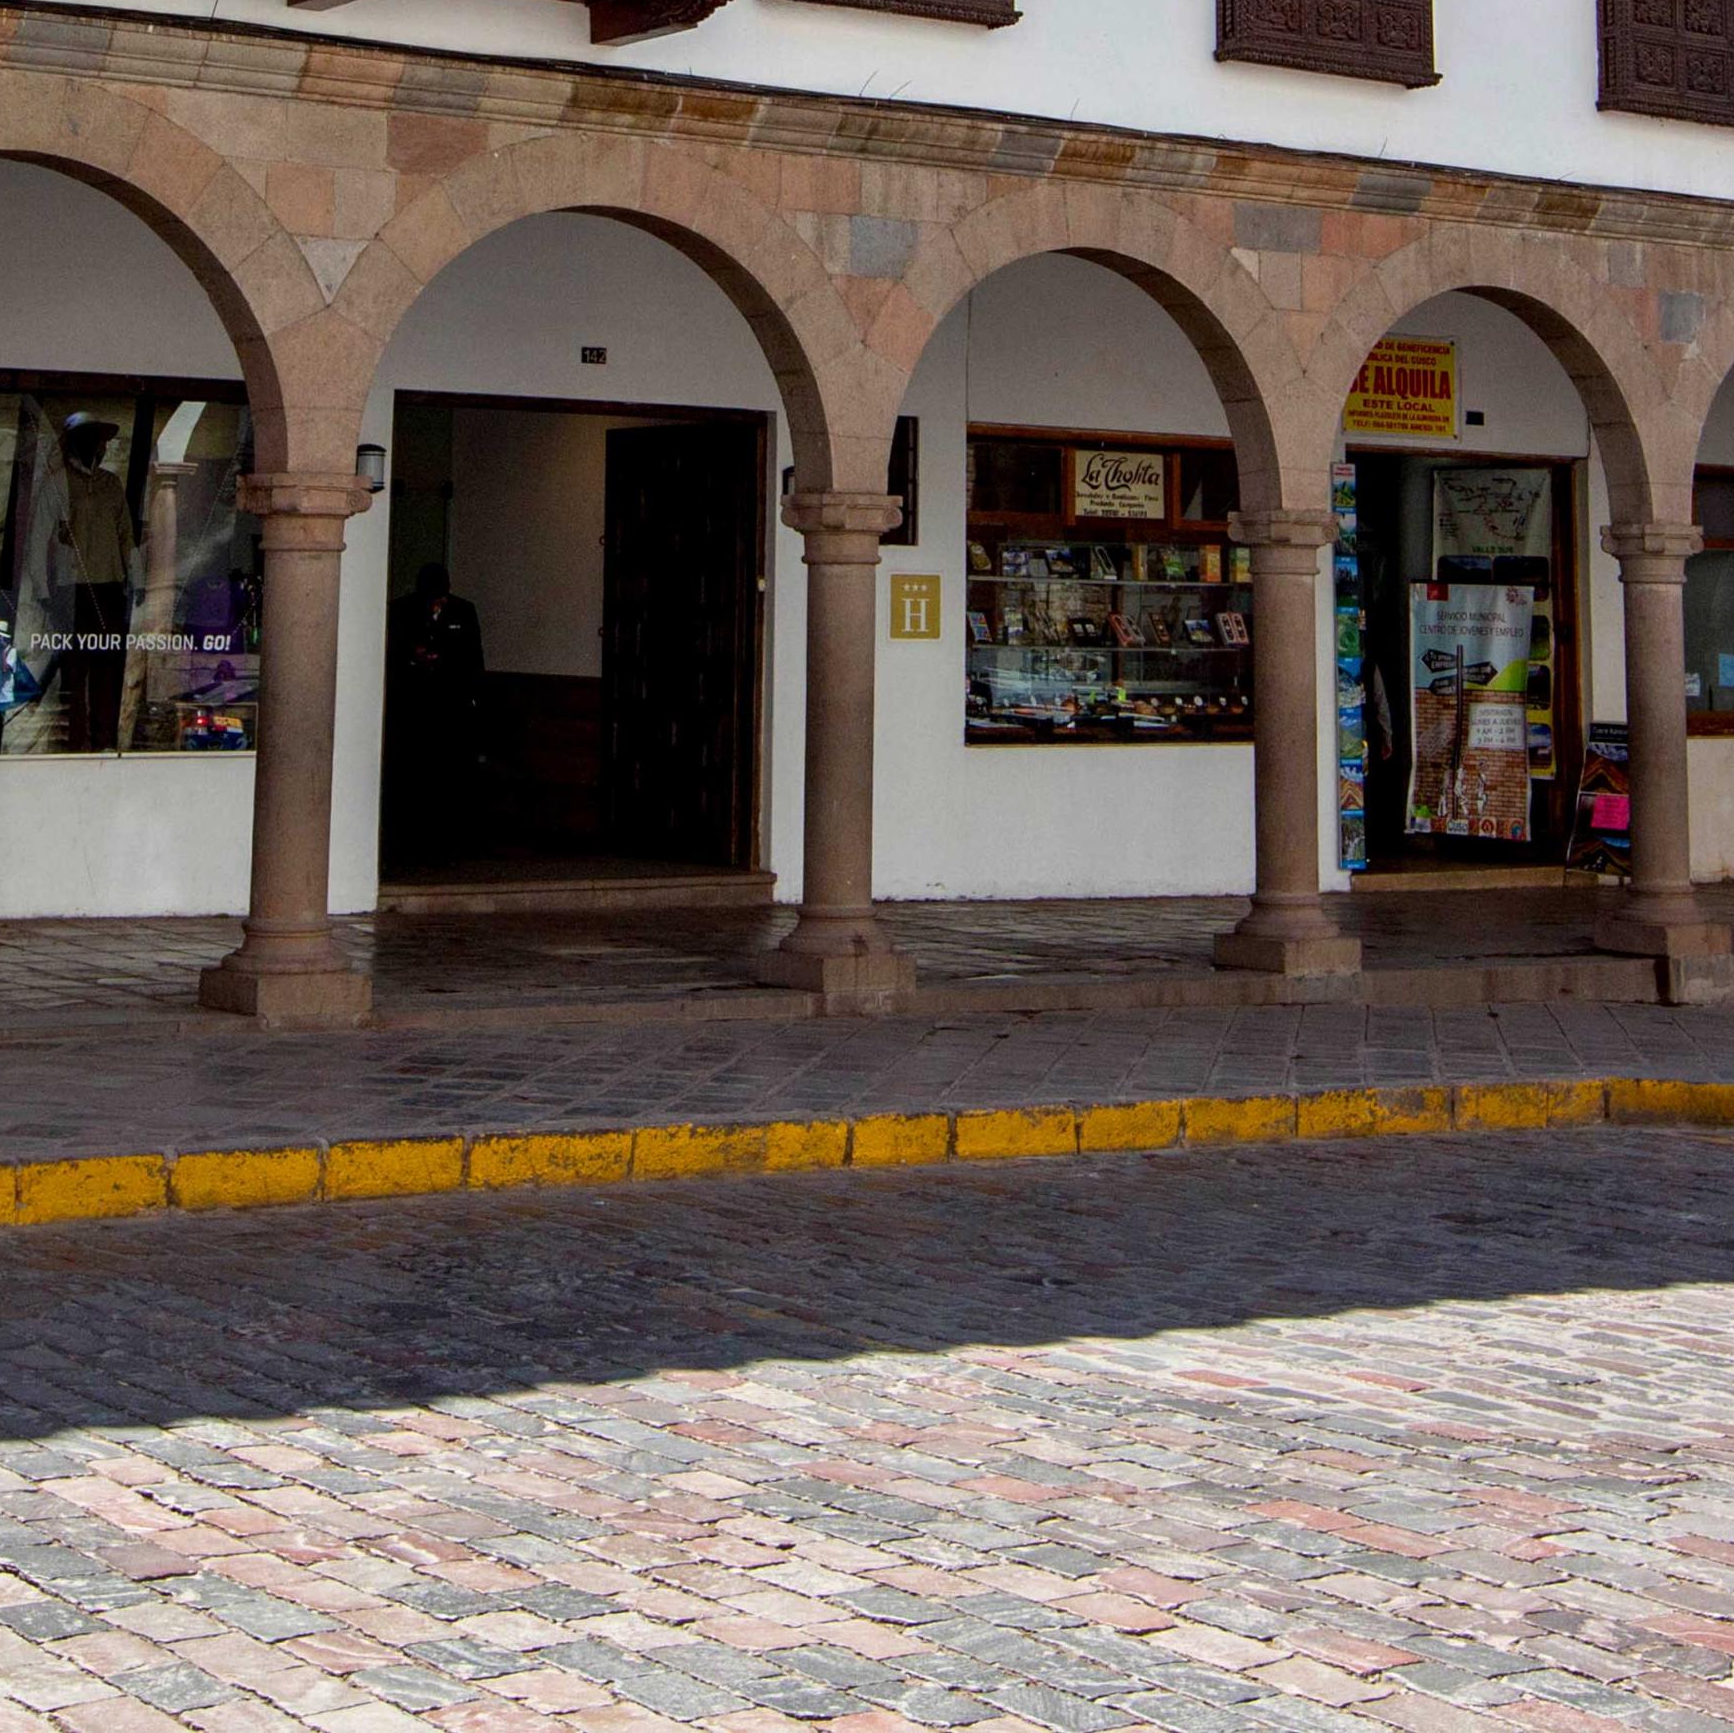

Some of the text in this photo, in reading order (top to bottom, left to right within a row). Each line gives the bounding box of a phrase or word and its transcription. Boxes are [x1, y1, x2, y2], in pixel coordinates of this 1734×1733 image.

[1373, 365, 1451, 400] ALQUILA
[1363, 399, 1435, 413] ESTE LOCAL
[1081, 453, 1104, 490] La
[901, 597, 931, 633] H
[1436, 610, 1506, 624] SERVICIO MUNICIPAL
[30, 633, 231, 651] PACK YOUR PASSION. GO!
